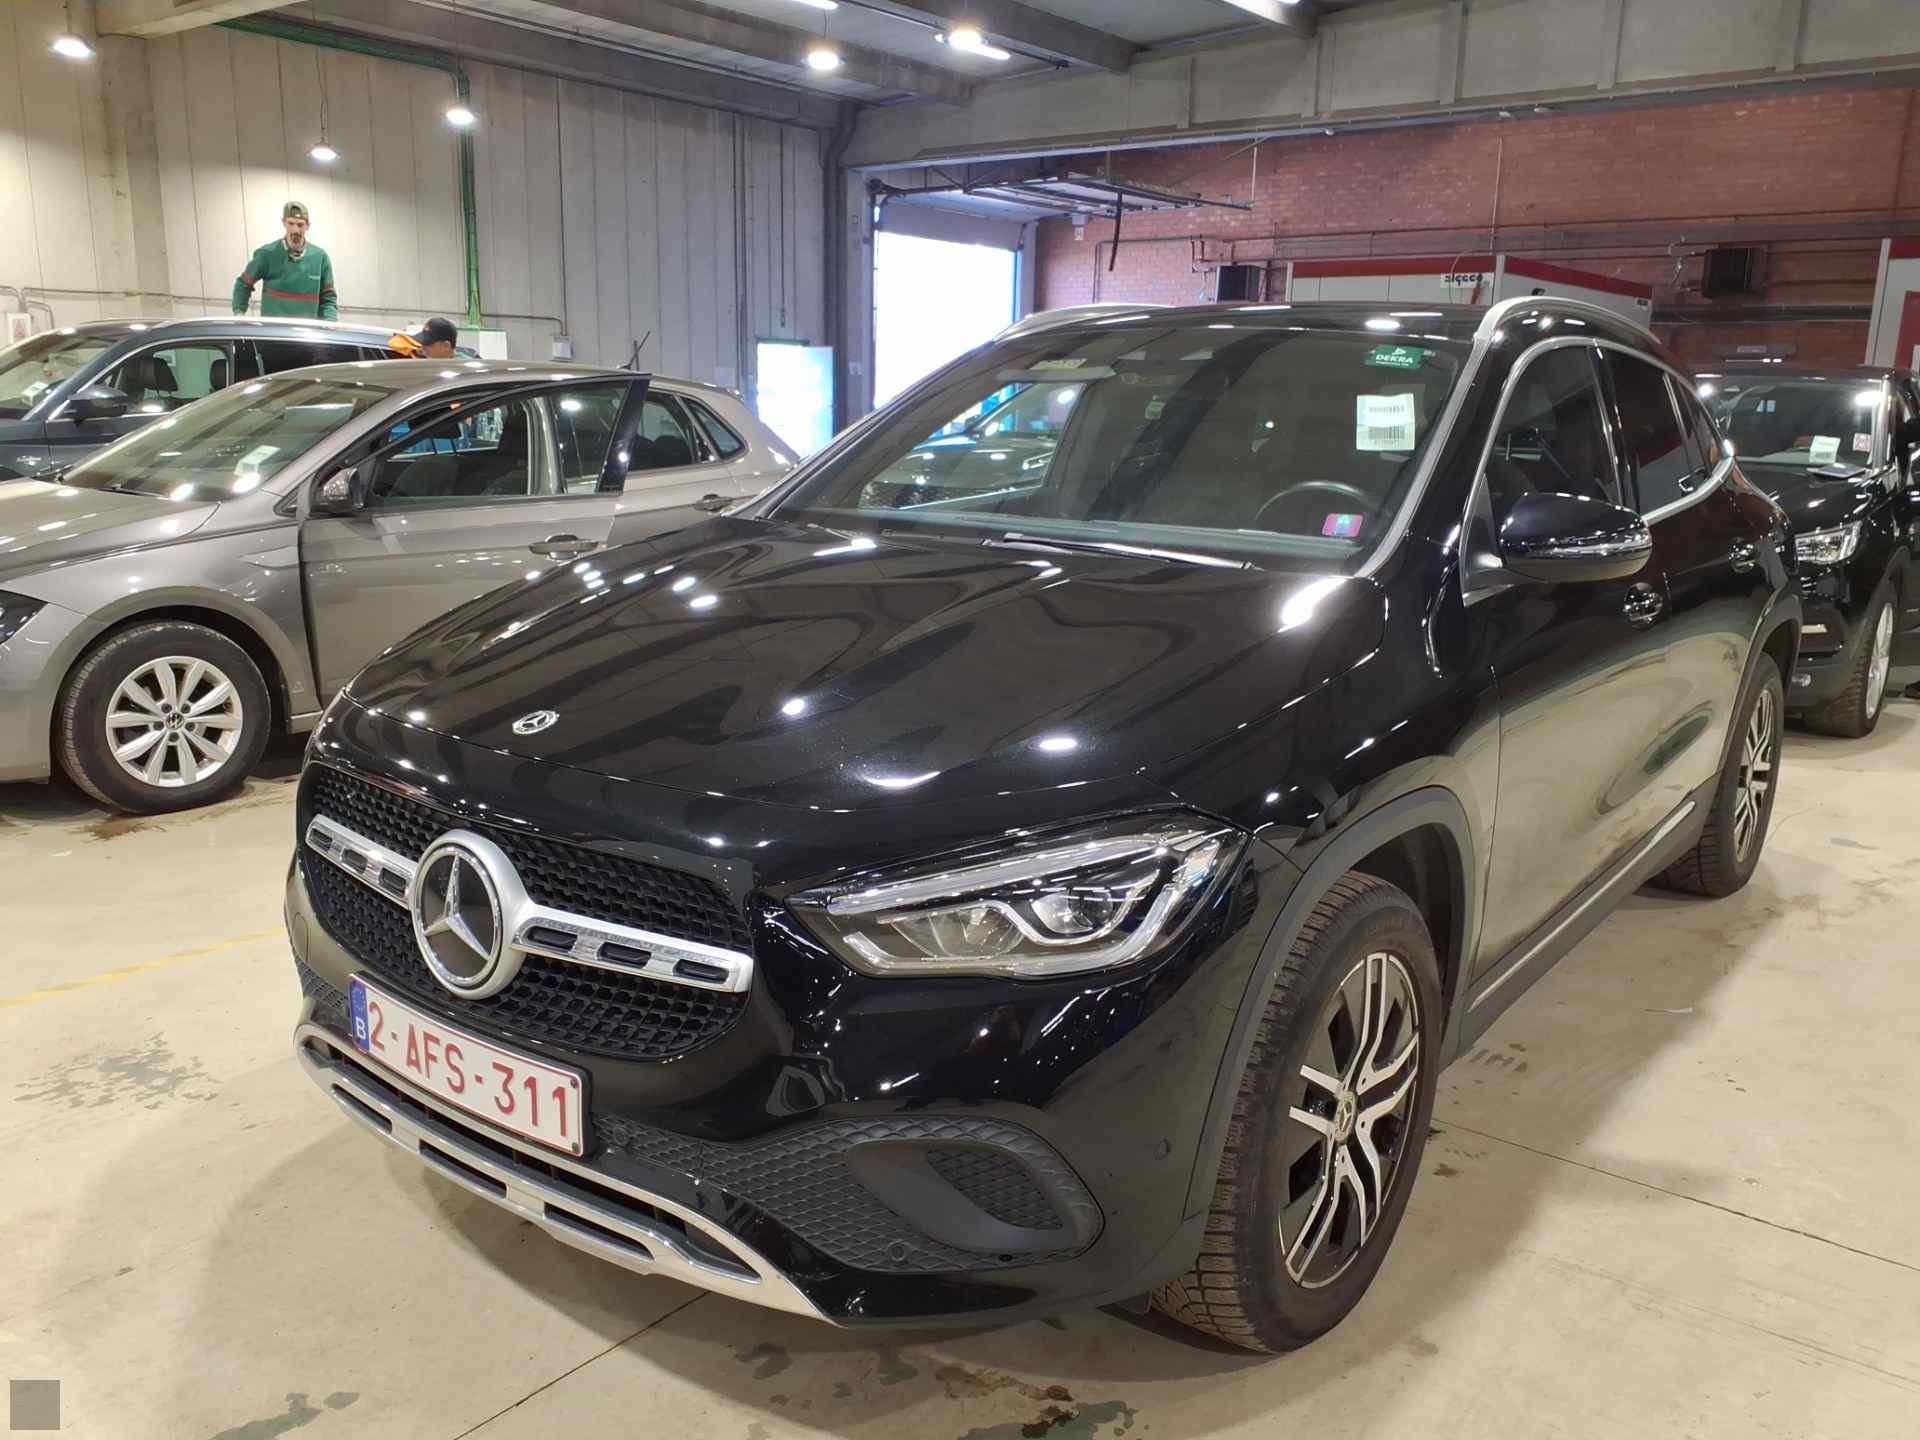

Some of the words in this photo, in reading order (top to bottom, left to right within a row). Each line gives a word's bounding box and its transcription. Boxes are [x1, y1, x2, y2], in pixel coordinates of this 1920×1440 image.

[1376, 354, 1413, 363] DEKRA
[355, 1016, 367, 1041] B
[368, 1001, 568, 1137] 2-AFS-311
